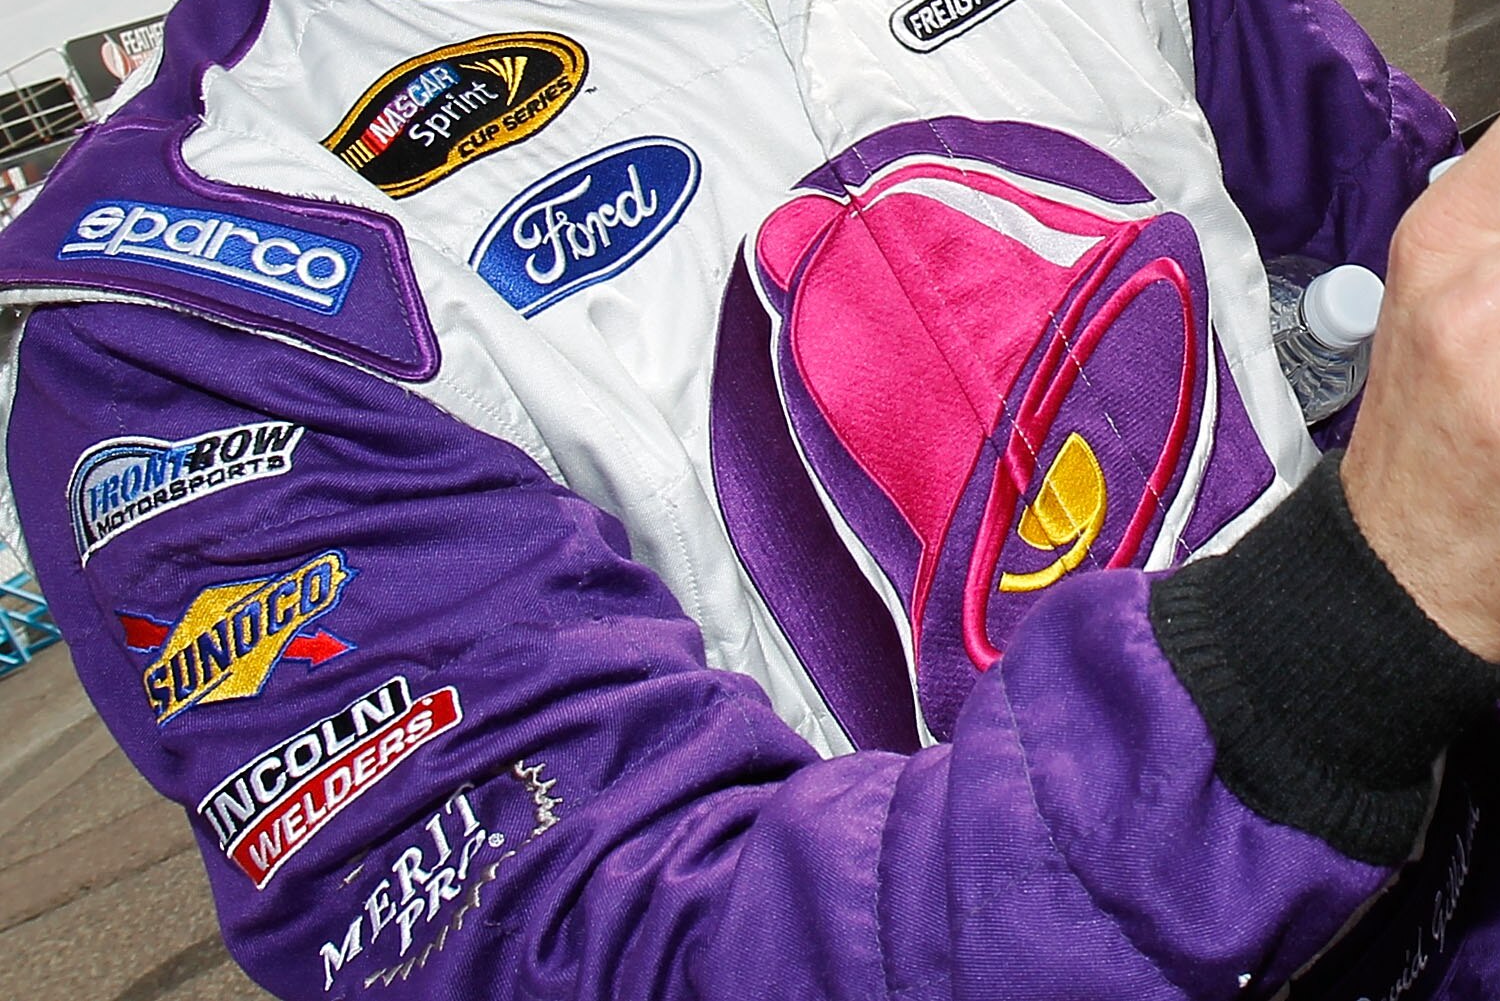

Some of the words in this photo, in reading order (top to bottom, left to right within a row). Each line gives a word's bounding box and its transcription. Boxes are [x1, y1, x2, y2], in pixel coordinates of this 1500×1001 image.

[369, 66, 460, 143] NASCAR
[409, 81, 499, 147] Sprint
[458, 124, 499, 158] CUP
[503, 75, 573, 132] SERIES
[76, 203, 348, 291] sparco
[512, 165, 658, 287] Ford
[89, 443, 193, 522] FRONT
[189, 426, 290, 472] ROW
[96, 456, 286, 537] MOTORSPORTS
[147, 562, 335, 716] SUNOCO
[206, 687, 395, 850] INCOLN
[248, 709, 433, 871] WELDERS
[319, 784, 481, 991] MERIT
